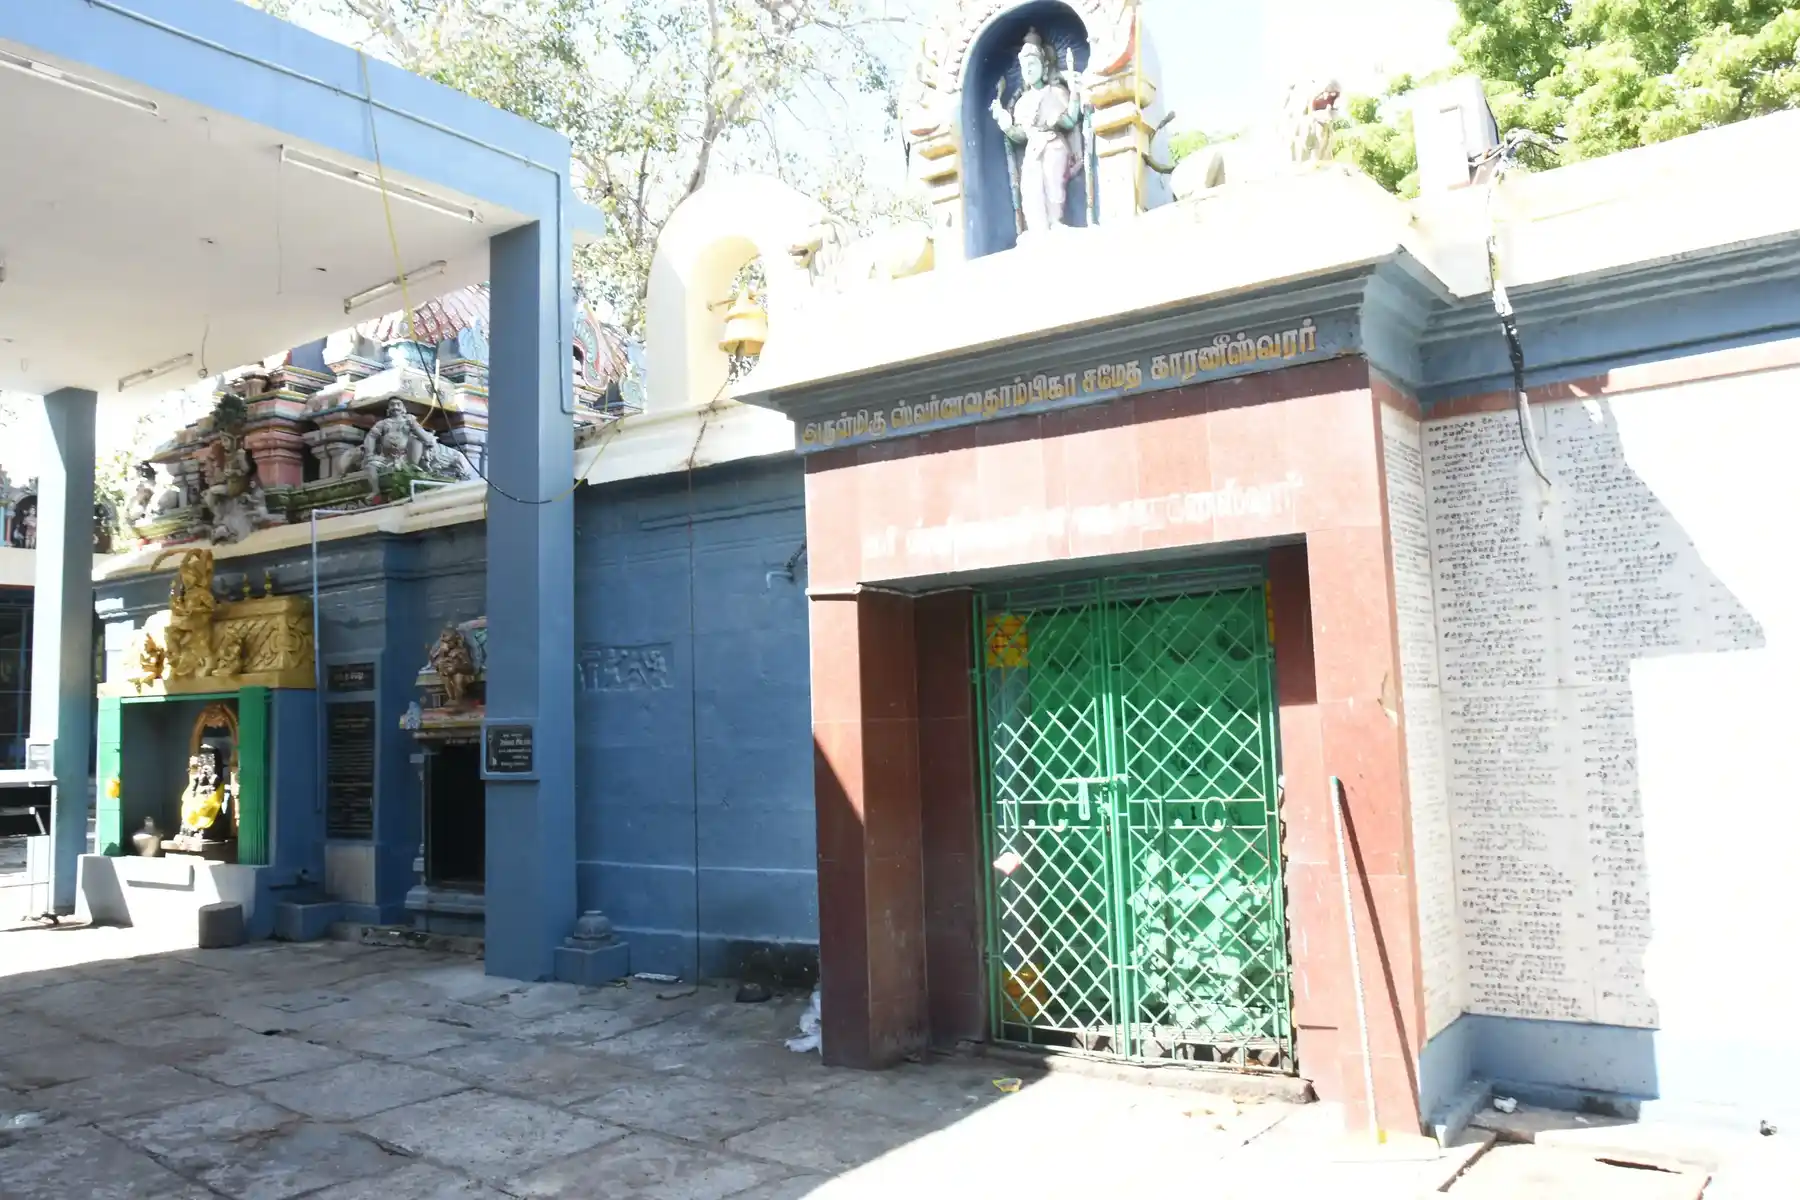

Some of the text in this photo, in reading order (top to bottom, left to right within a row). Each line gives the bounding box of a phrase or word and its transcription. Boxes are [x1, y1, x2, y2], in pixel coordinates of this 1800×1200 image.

[803, 409, 887, 446] அருள்மிகு
[1082, 359, 1143, 392] சமேத
[1150, 318, 1317, 382] காரணீஸ்வரர்
